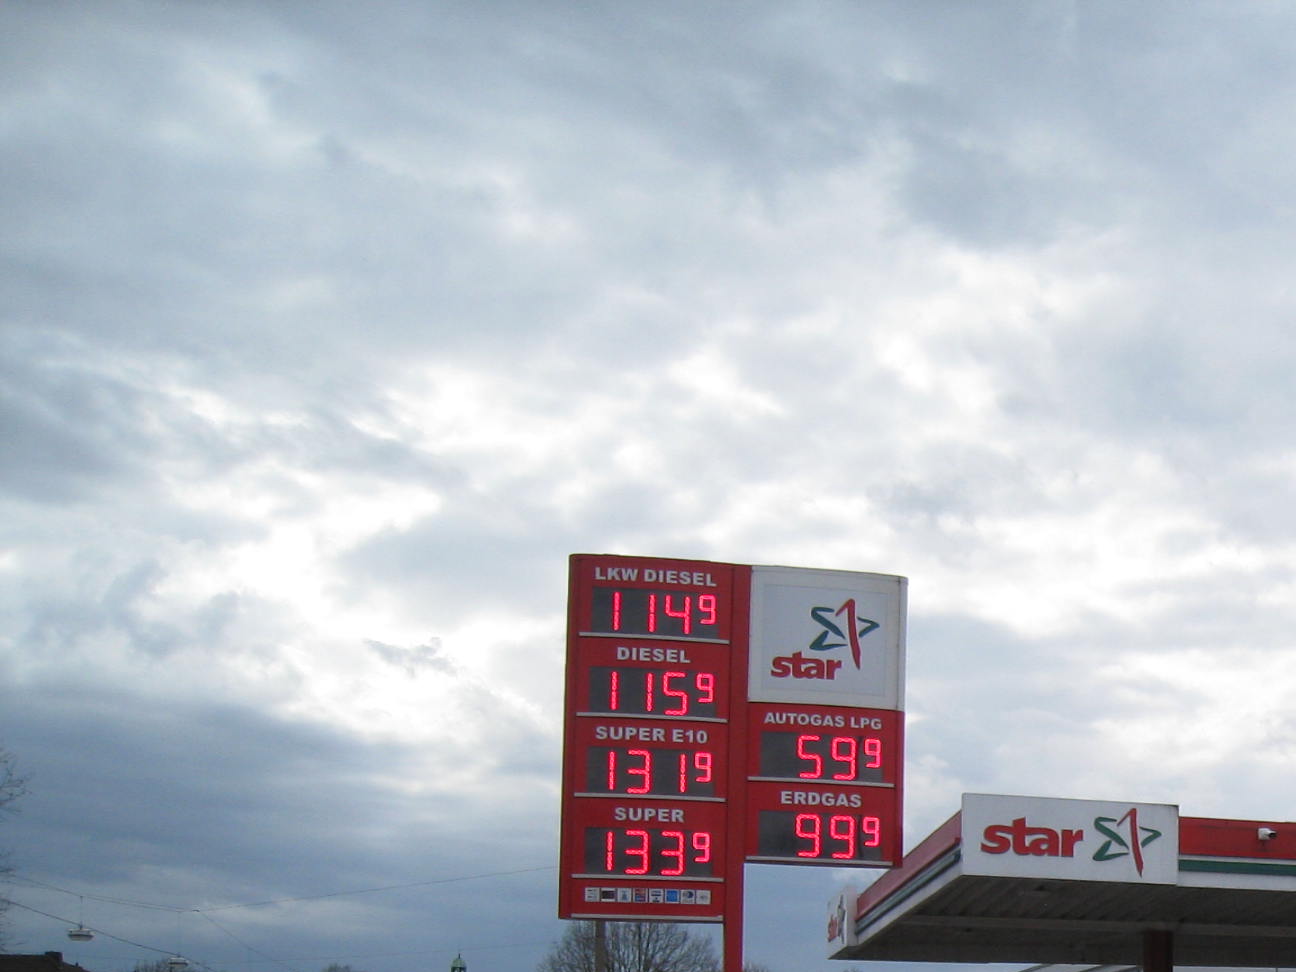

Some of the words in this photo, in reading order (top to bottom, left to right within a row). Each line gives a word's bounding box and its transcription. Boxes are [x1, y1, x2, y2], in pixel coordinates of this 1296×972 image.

[595, 567, 638, 581] LKW
[643, 569, 717, 587] DIESEL
[616, 647, 691, 663] DIESEL
[770, 651, 843, 680] star
[764, 712, 845, 728] AUTOGAS
[850, 717, 882, 730] LPG
[595, 726, 665, 742] SUPER
[672, 730, 708, 744] E10
[780, 791, 862, 808] ERDGAS
[614, 807, 685, 823] SUPER
[980, 817, 1084, 857] star
